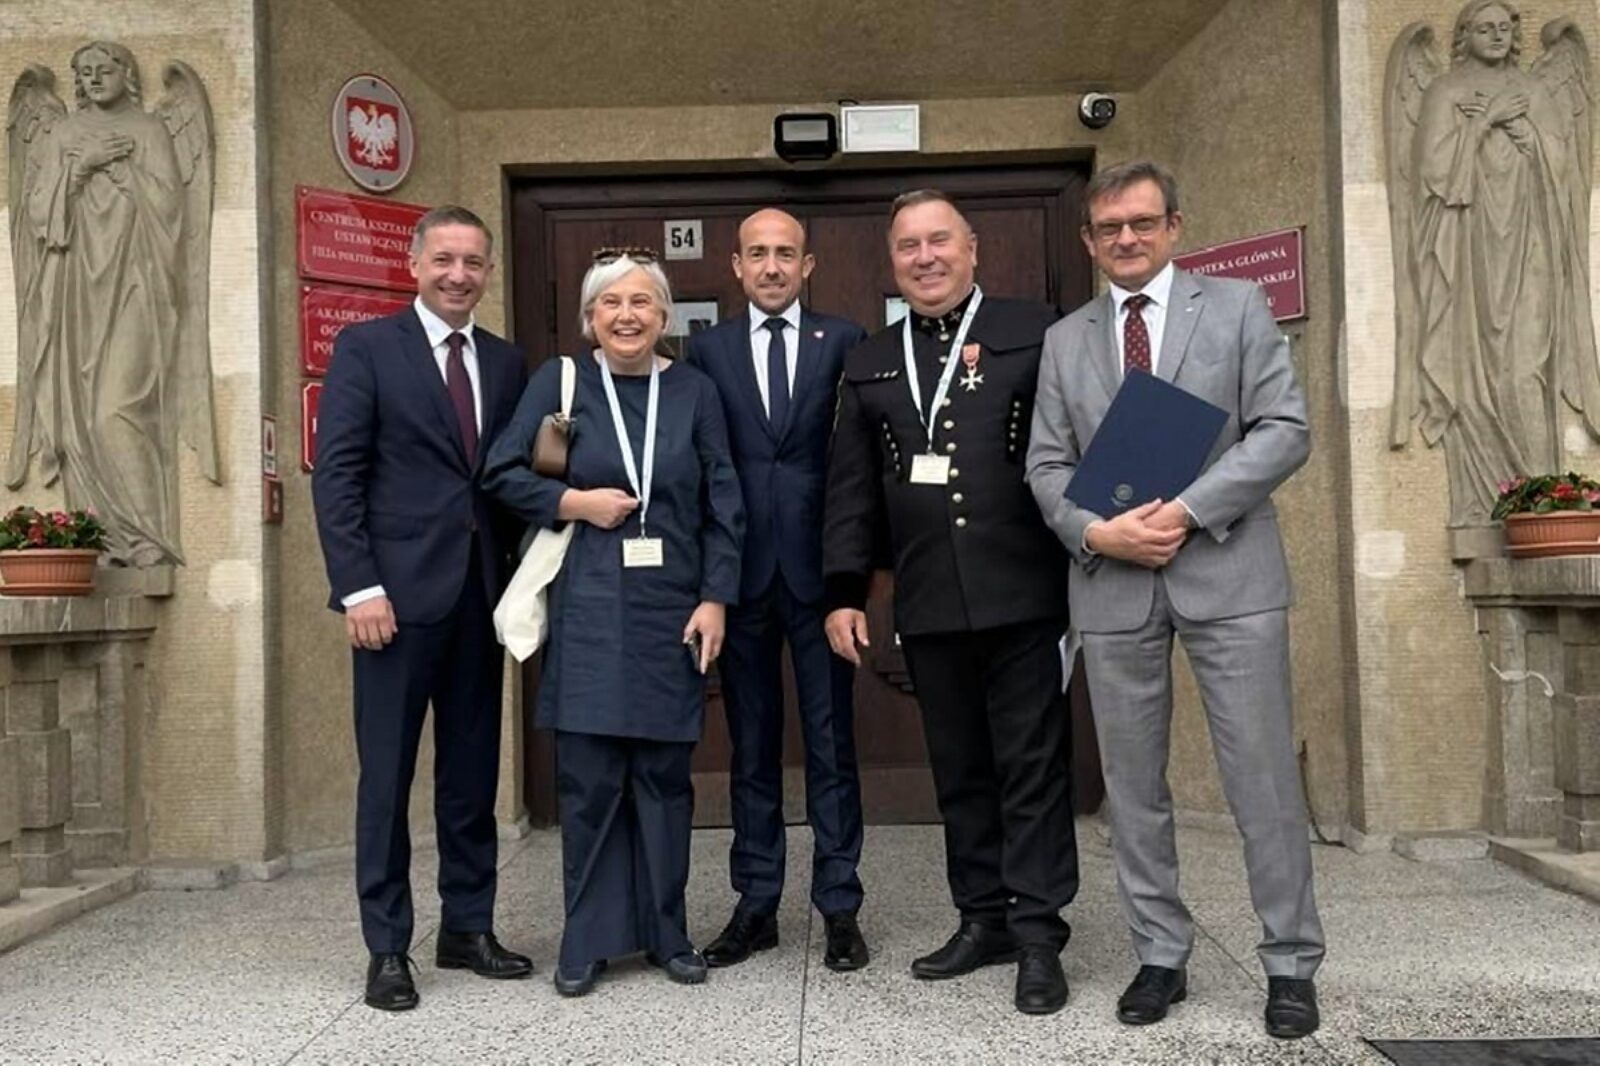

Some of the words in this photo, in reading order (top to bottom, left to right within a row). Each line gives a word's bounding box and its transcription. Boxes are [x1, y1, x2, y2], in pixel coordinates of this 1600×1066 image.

[310, 210, 366, 230] CENTRUM
[334, 230, 410, 252] USTAWICZNE
[671, 227, 695, 248] 54
